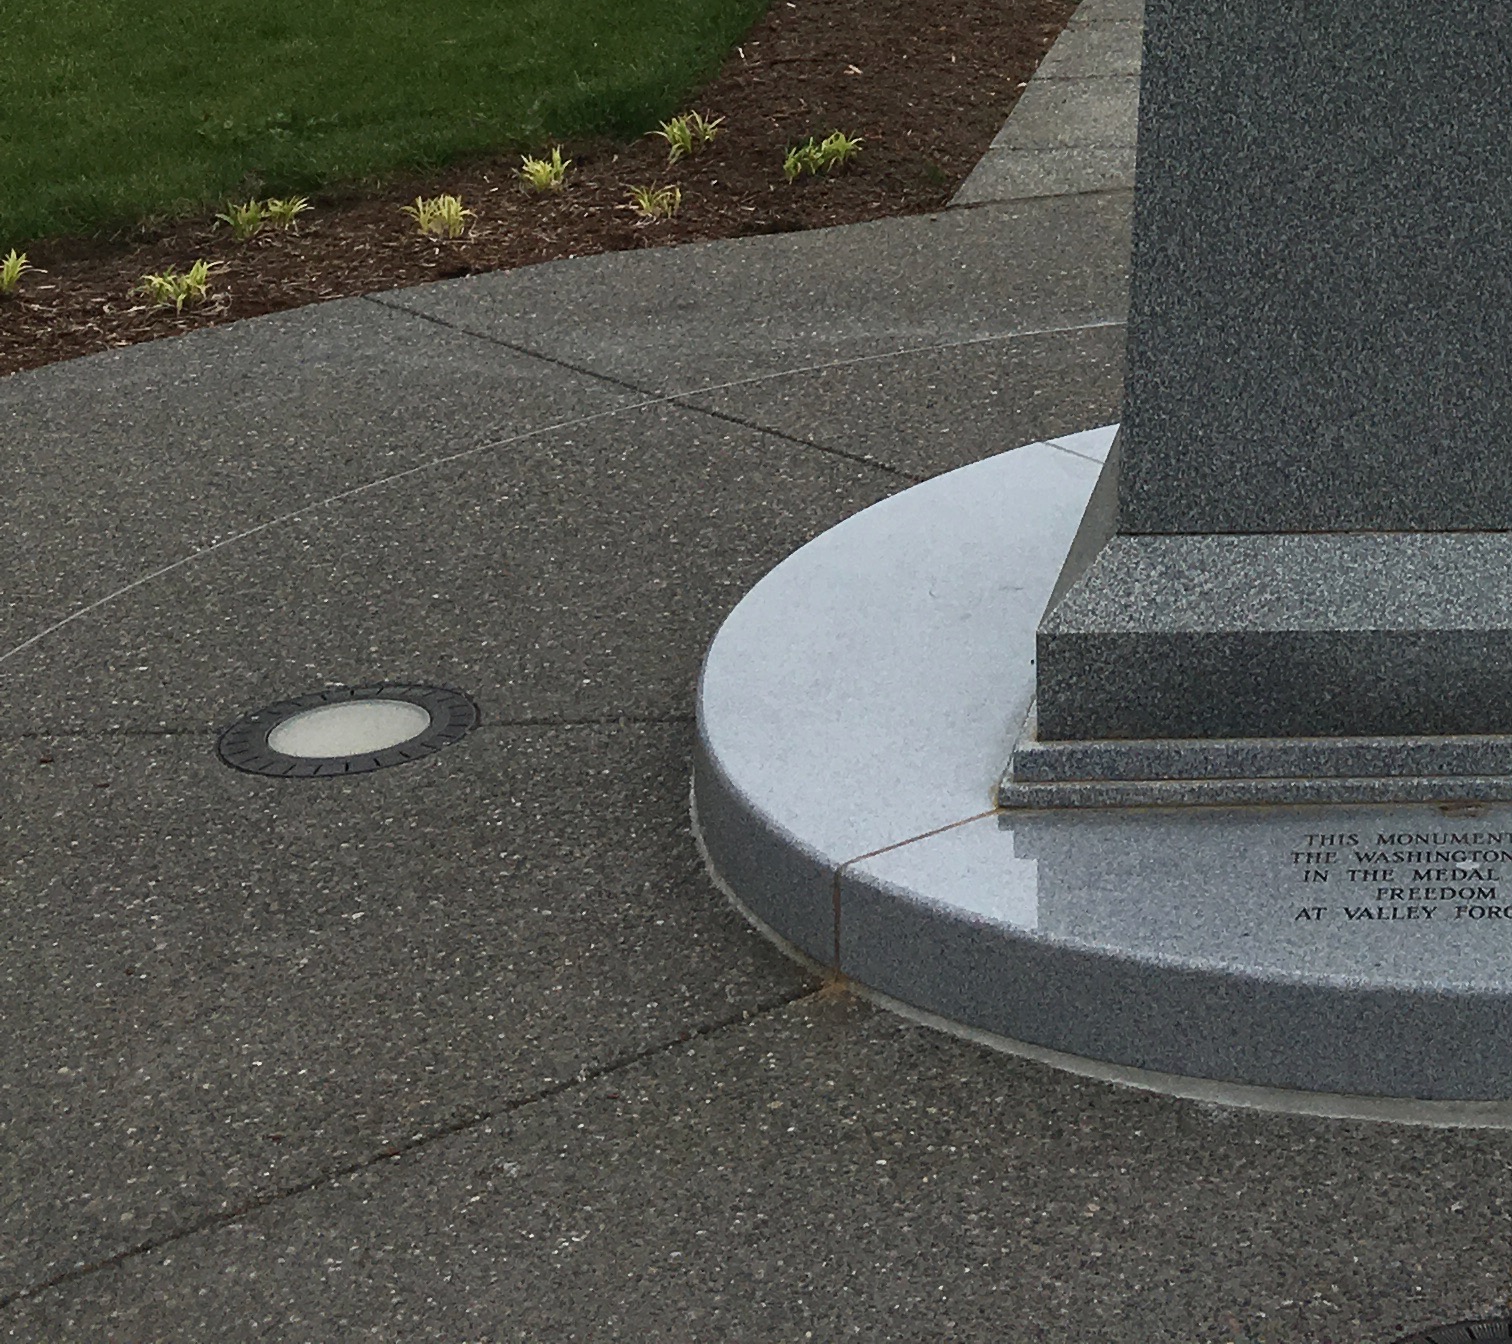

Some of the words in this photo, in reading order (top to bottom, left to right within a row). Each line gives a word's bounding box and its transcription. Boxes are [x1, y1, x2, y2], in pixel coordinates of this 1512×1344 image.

[1305, 833, 1359, 847] THIS
[1291, 852, 1338, 864] THE
[1303, 870, 1328, 883] IN
[1348, 869, 1394, 882] THE
[1412, 868, 1500, 881] MEDAL
[1376, 888, 1497, 901] FREEDOM
[1295, 907, 1327, 920] AT
[1343, 906, 1437, 920] VALLEY
